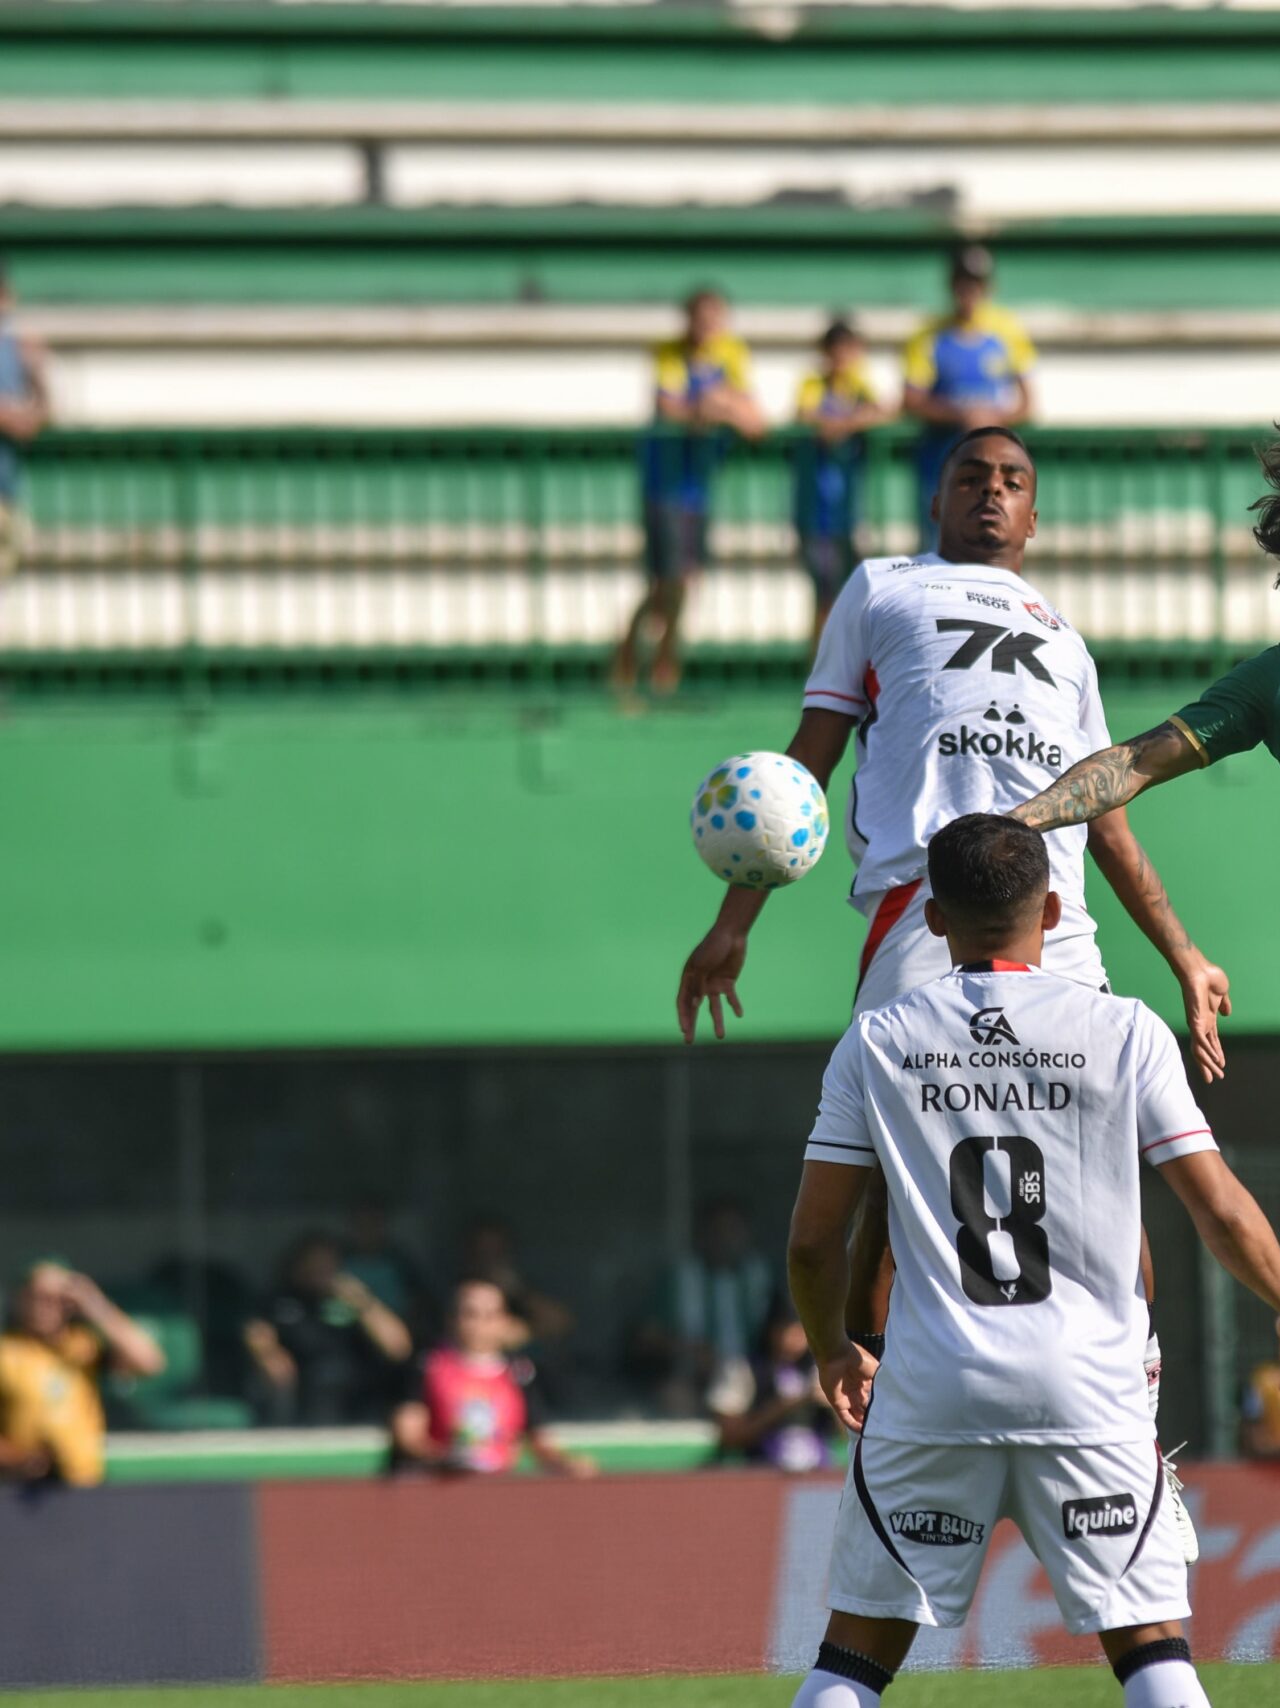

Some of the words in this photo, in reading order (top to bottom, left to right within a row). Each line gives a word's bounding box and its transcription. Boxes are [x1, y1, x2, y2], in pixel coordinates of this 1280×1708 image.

[936, 618, 1058, 690] 7K
[938, 724, 1061, 767] skokka
[902, 1052, 962, 1069] ALPHA
[968, 1048, 1086, 1069] CONSÓRCIO
[921, 1082, 1071, 1112] RONALD
[1024, 1171, 1040, 1204] SBS
[949, 1136, 1053, 1307] 8
[891, 1511, 937, 1533] VAPT
[940, 1515, 984, 1544] BLUE
[920, 1532, 954, 1544] TINTAS
